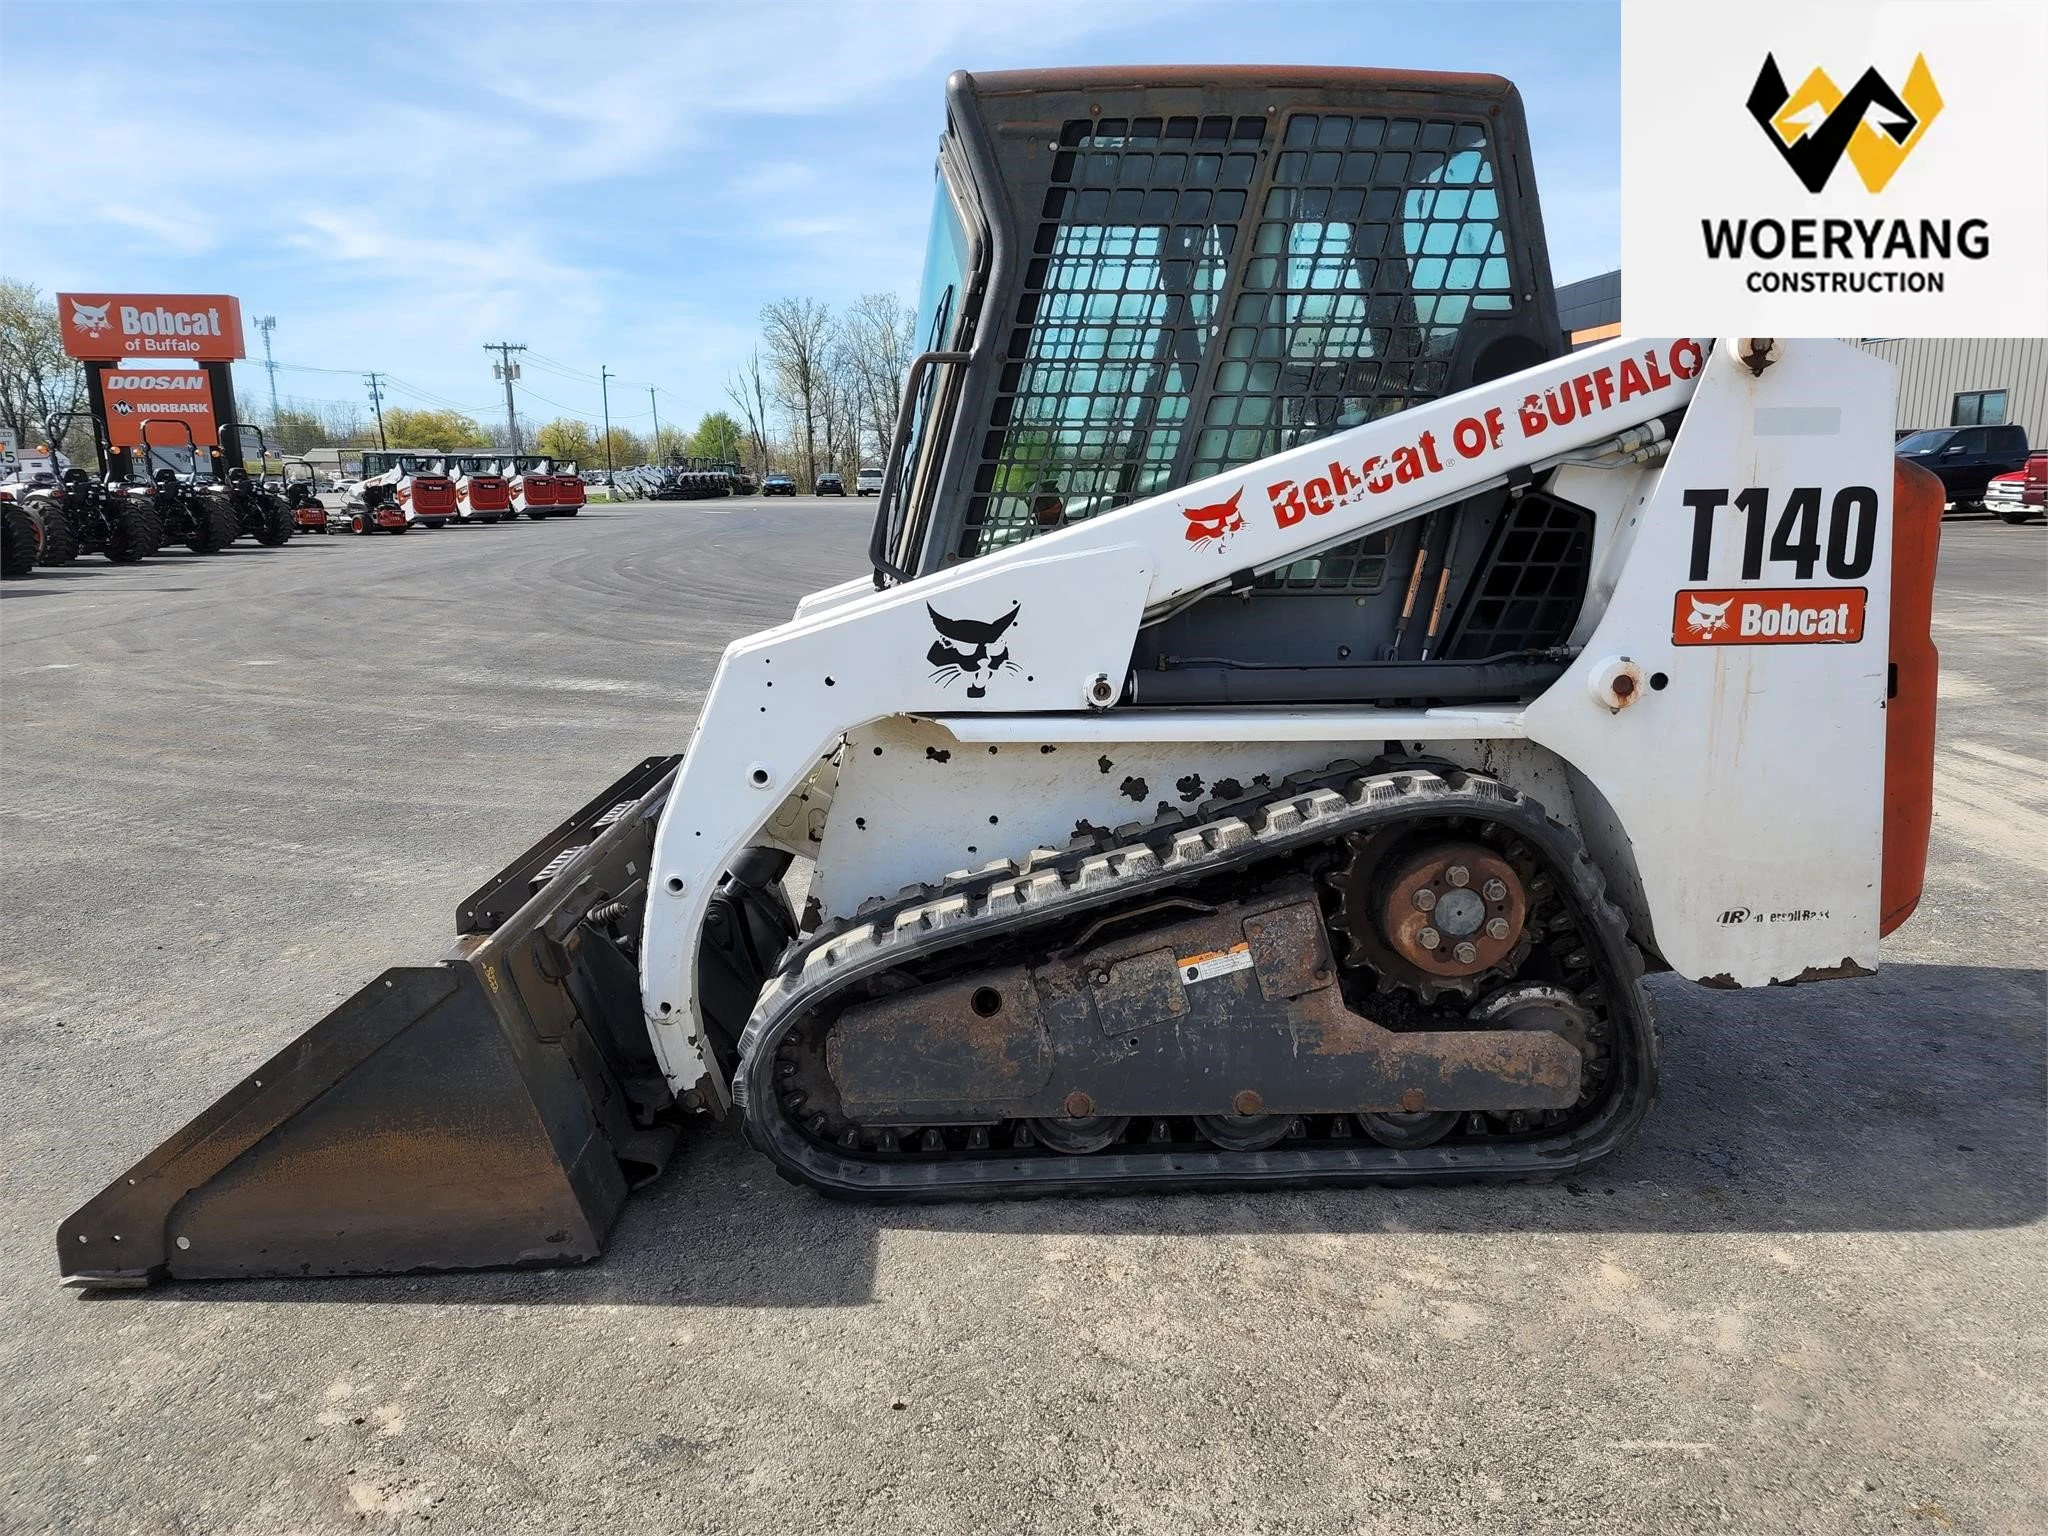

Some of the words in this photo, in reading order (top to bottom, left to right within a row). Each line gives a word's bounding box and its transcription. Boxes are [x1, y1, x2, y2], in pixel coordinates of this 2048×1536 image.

[120, 306, 221, 336] Bobcat
[125, 338, 141, 352] of
[145, 338, 200, 352] Buffalo
[107, 376, 203, 390] DOOSAN
[137, 403, 208, 413] MORBARK
[1267, 430, 1444, 529] Bobcat
[1453, 407, 1505, 459] OF
[1517, 338, 1703, 438] BUFFALO
[1683, 486, 1878, 581] T140
[1740, 603, 1849, 636] Bobcat
